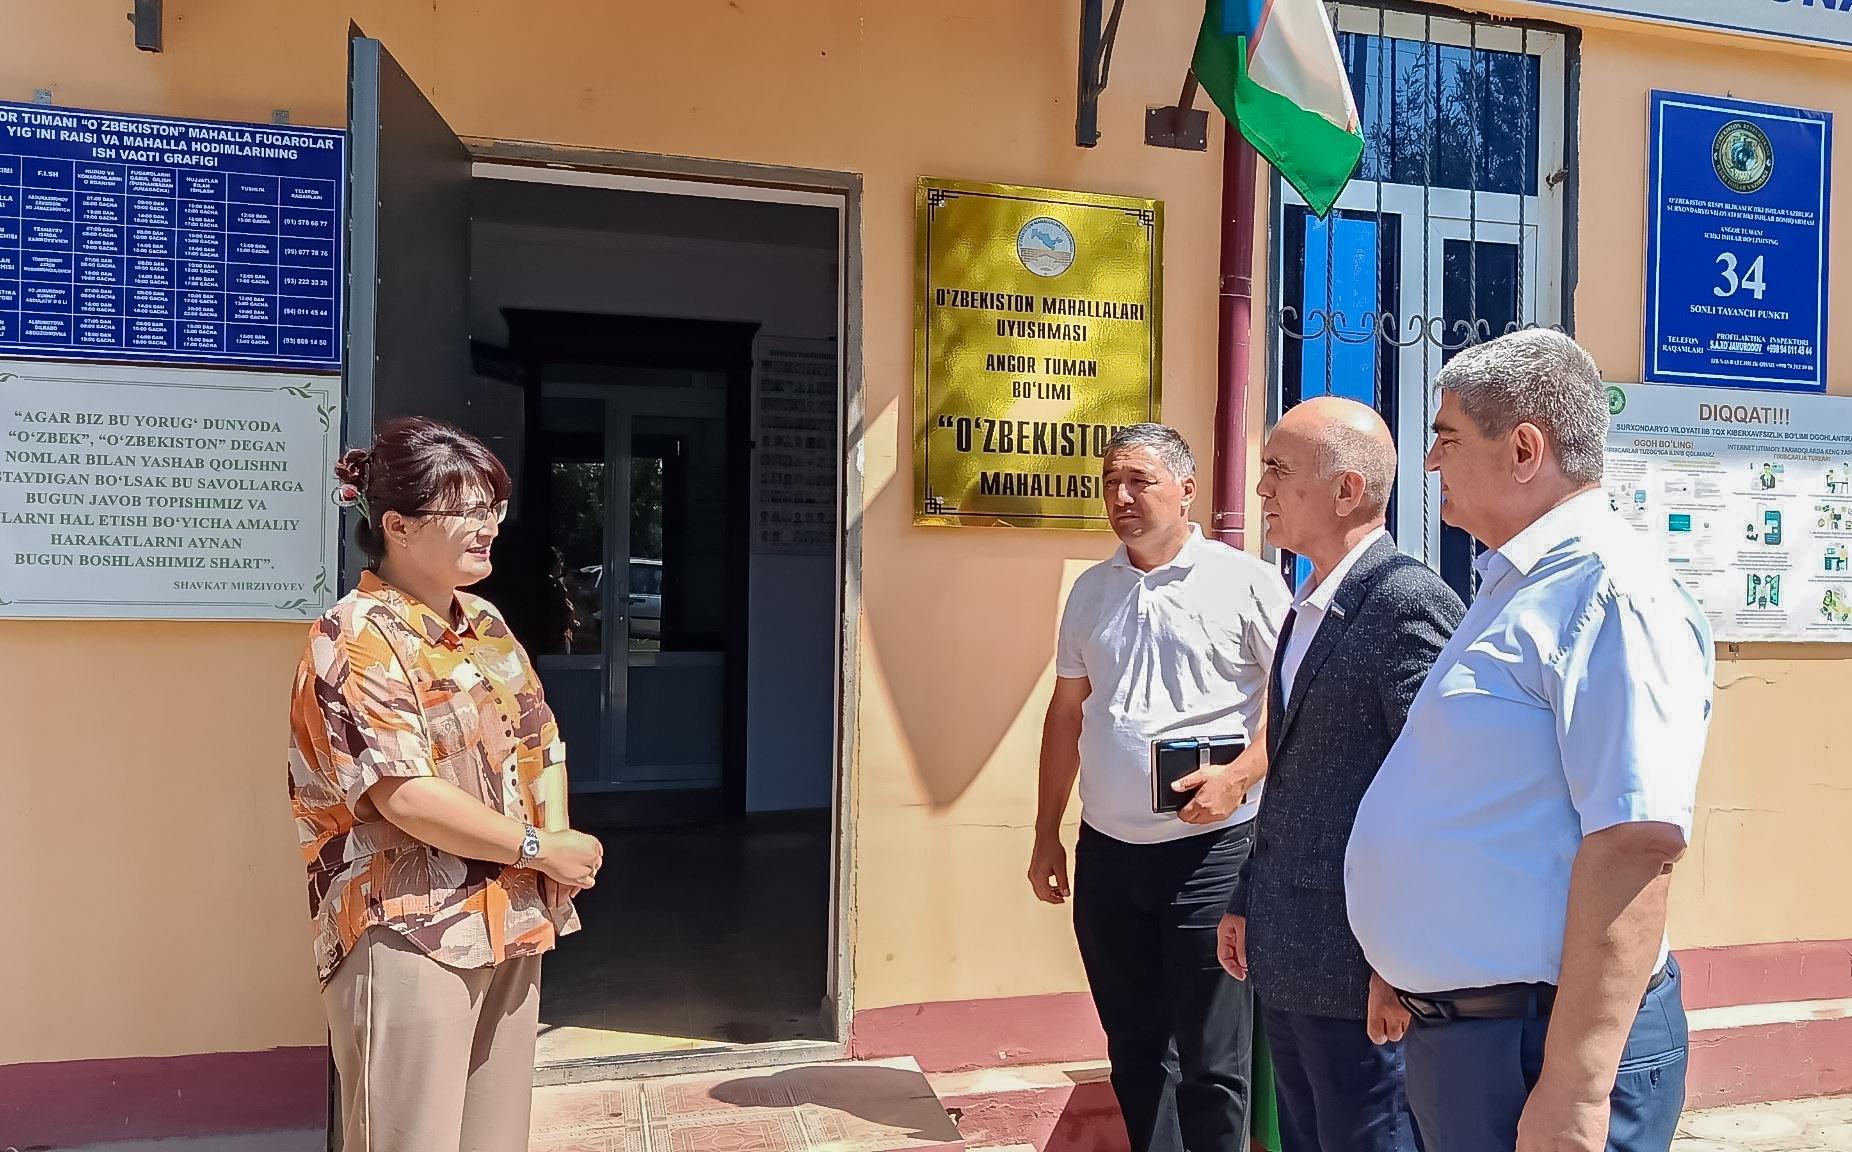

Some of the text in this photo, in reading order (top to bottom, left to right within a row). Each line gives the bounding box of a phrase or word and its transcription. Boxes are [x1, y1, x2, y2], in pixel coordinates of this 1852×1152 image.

[22, 113, 77, 128] TUMANI
[189, 128, 252, 142] MAHALLA
[256, 134, 334, 149] FUQAROLAR
[60, 130, 97, 144] RAISI
[101, 134, 119, 146] VA
[123, 136, 187, 151] MAHALLA
[191, 141, 298, 160] HODIMLARINING
[92, 147, 218, 167] ISH VAQTI GRAFIGI
[1713, 251, 1767, 300] 34
[1042, 297, 1144, 321] MAHALLALARI
[1690, 304, 1789, 320] SONLI TAYANCH PUNKTI
[997, 319, 1087, 342] UYUSHMASI
[1666, 335, 1699, 345] TELEFON
[1716, 332, 1766, 344] PROFILAKTIKA
[986, 354, 1097, 378] ANGOR TUMAN
[14, 410, 71, 424] “AGAR
[75, 413, 104, 425] BIZ
[108, 414, 130, 426] BU
[203, 418, 282, 433] DUNYODA
[1699, 403, 1790, 426] DIQQAT!!!
[1616, 423, 1669, 433] SURXONDARYO
[1670, 426, 1701, 435] VILOYATI
[1726, 429, 1784, 439] KIBERXAVFSIZLIK
[230, 439, 286, 452] DEGAN
[1633, 439, 1658, 448] OGOH
[5, 450, 288, 472] NOMLAR BILAN YASHAB QOLISHNI
[0, 471, 90, 486] TAYDIGAN
[171, 477, 193, 489] BU
[197, 478, 304, 492] SAVOLLARGA
[980, 471, 1100, 499] MAHALLASI
[25, 492, 267, 511] BUGUN JAVOB TOPISHIMIZ VA
[0, 511, 55, 525] LARNI
[60, 513, 94, 526] HAL
[99, 514, 147, 527] ETISH
[235, 518, 300, 531] AMALIY
[50, 533, 242, 549] HARAKATLARNI AYNAN
[14, 553, 74, 566] BUGUN
[79, 554, 206, 568] BOSHLASHIMIZ
[173, 580, 305, 592] SHAVKAT MIRZIYOYEV
